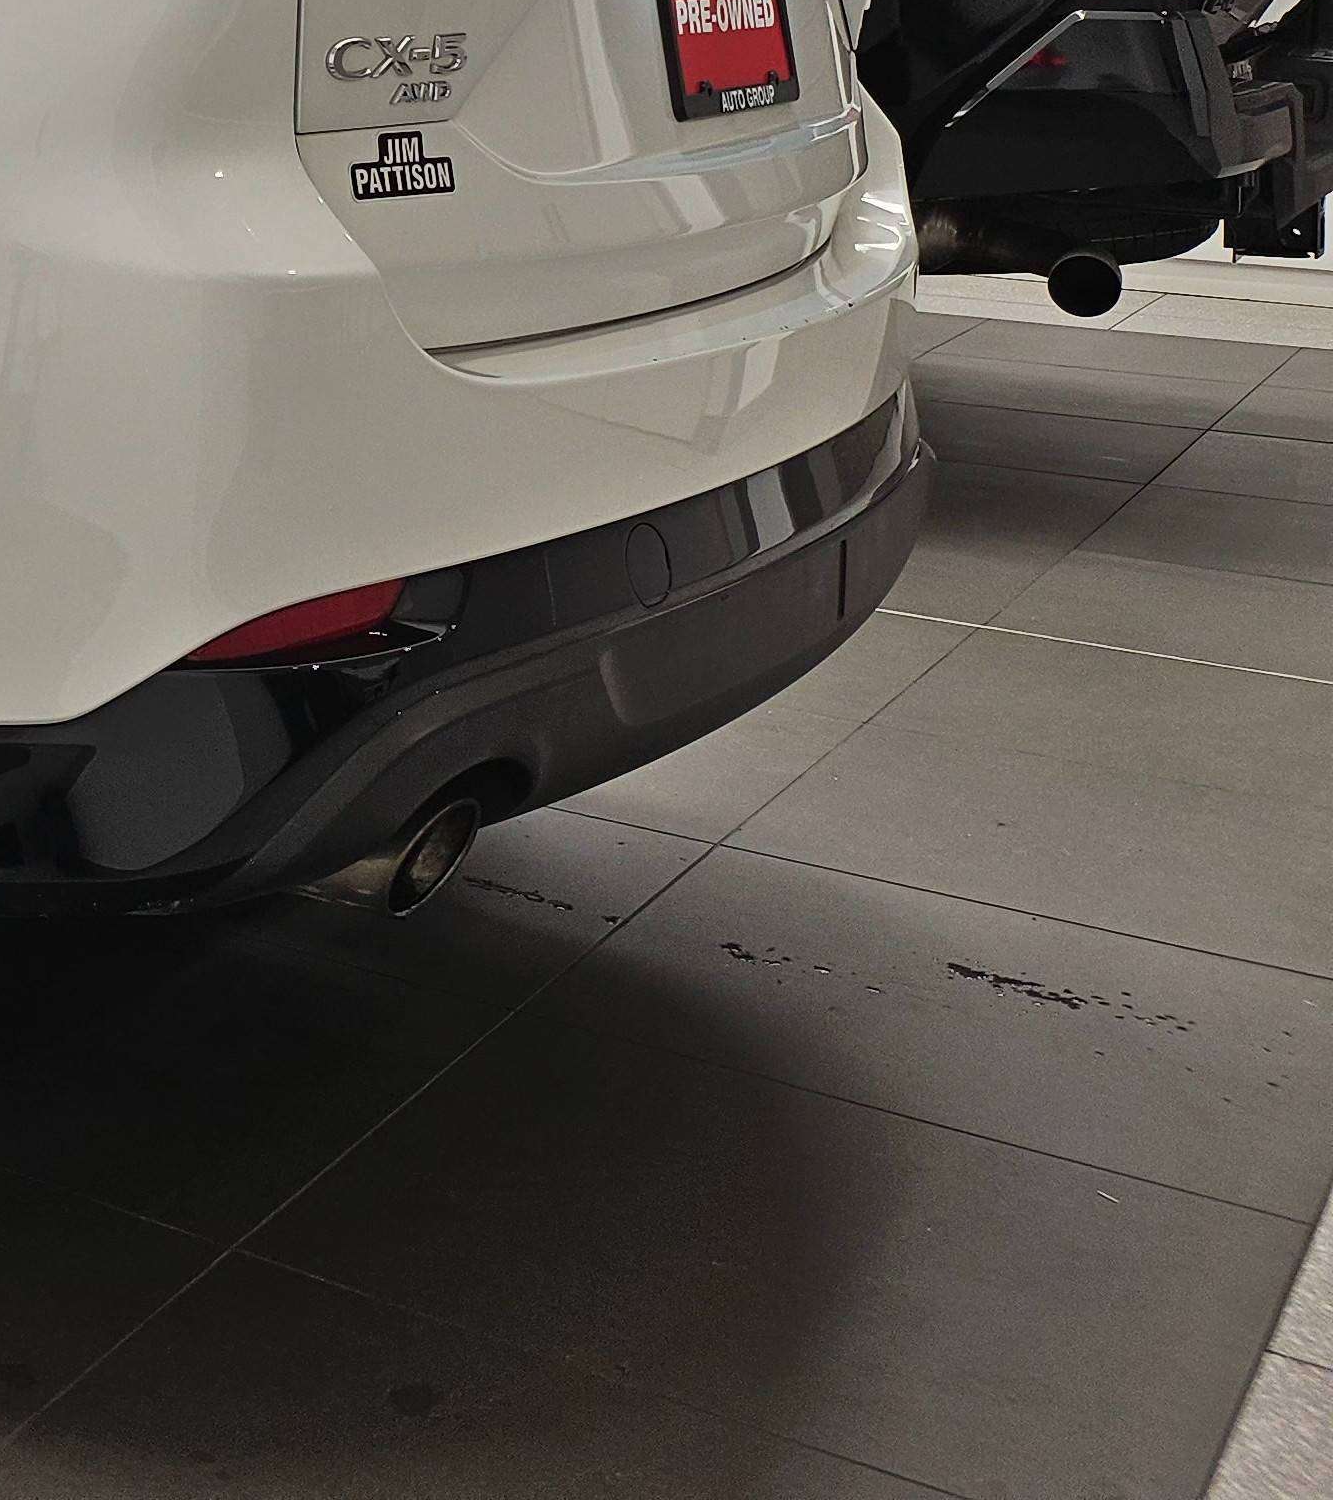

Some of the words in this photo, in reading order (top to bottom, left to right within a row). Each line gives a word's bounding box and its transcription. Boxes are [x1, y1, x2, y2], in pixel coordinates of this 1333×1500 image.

[325, 33, 468, 81] CX-5
[389, 80, 452, 105] AWD
[722, 90, 745, 112] AUTO
[746, 85, 775, 108] GROUP
[383, 136, 420, 164] JIM
[355, 162, 452, 195] PATTISON
